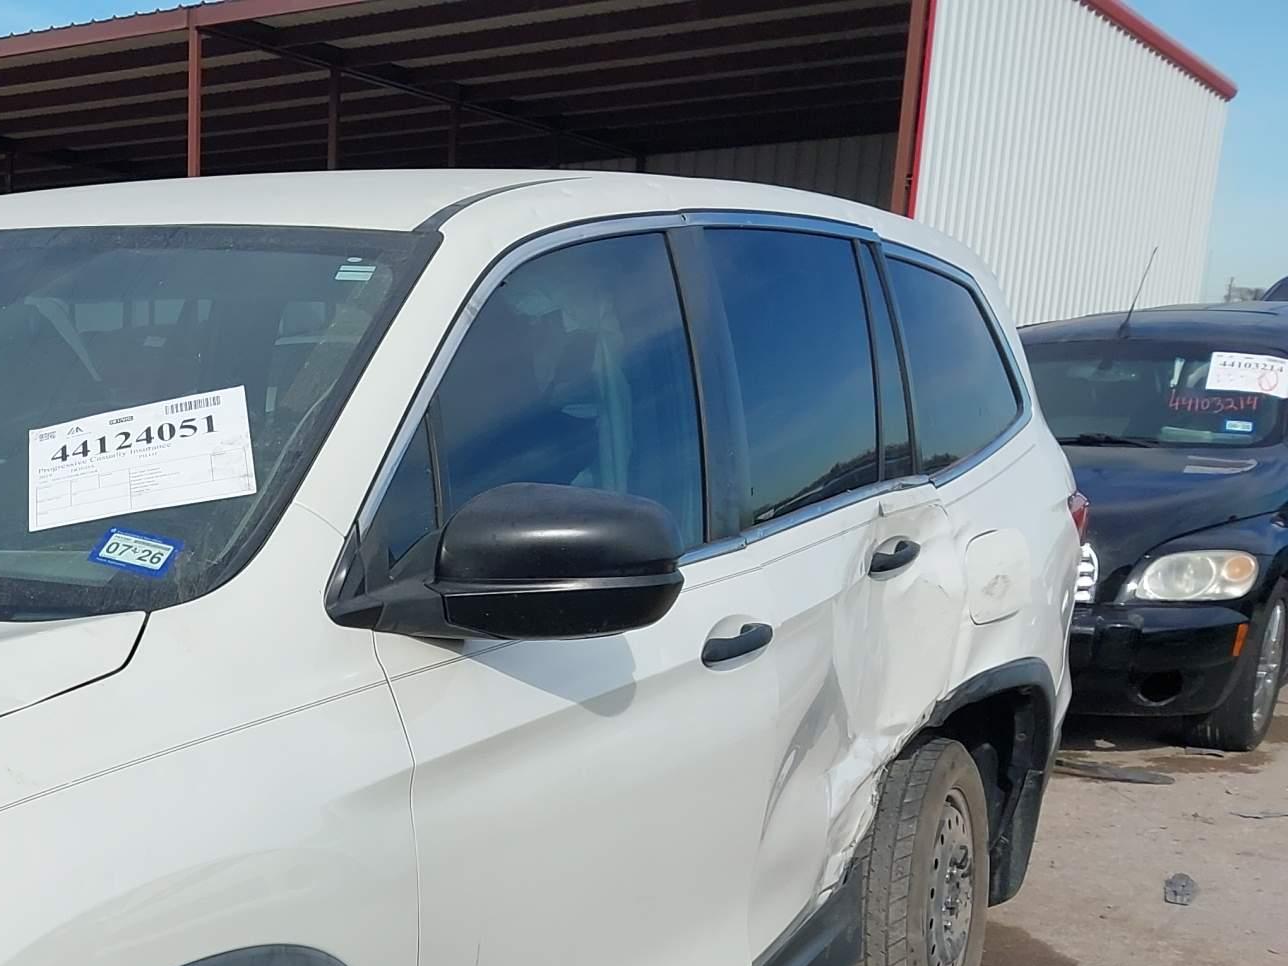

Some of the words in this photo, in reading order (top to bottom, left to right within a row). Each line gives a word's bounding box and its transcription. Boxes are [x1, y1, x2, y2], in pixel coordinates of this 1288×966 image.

[1218, 360, 1284, 373] 44103214
[1168, 395, 1259, 413] 44103214
[51, 414, 218, 462] 44124051
[106, 541, 133, 556] 07
[136, 549, 164, 565] 26
